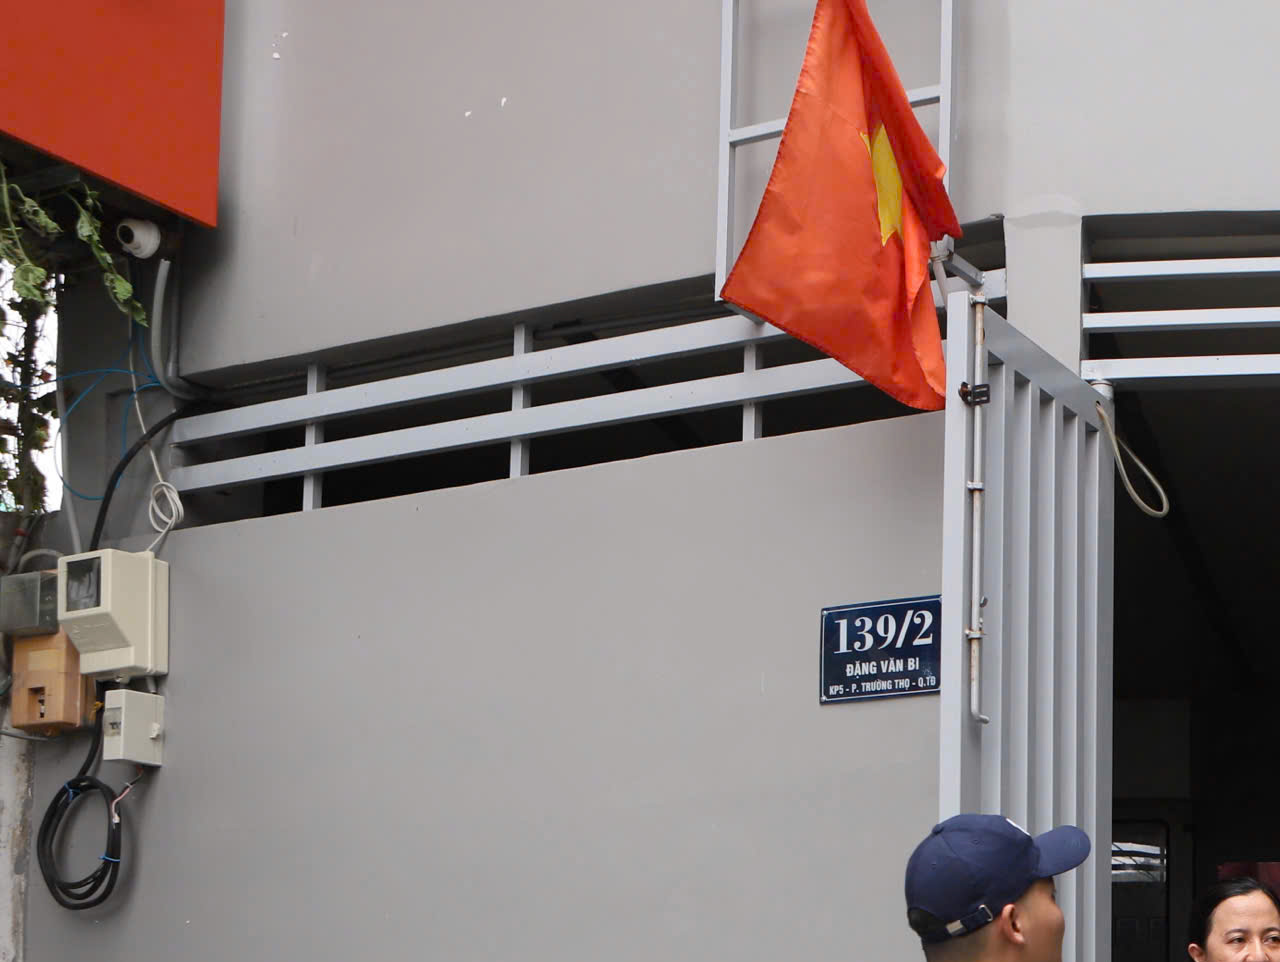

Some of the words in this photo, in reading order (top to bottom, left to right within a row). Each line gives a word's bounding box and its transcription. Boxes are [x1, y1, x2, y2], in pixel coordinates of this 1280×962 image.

[833, 610, 933, 654] 139/2
[845, 661, 877, 679] ĐẶNG
[880, 657, 904, 673] VĂN
[829, 685, 844, 696] KP5
[894, 679, 910, 690] THỌ
